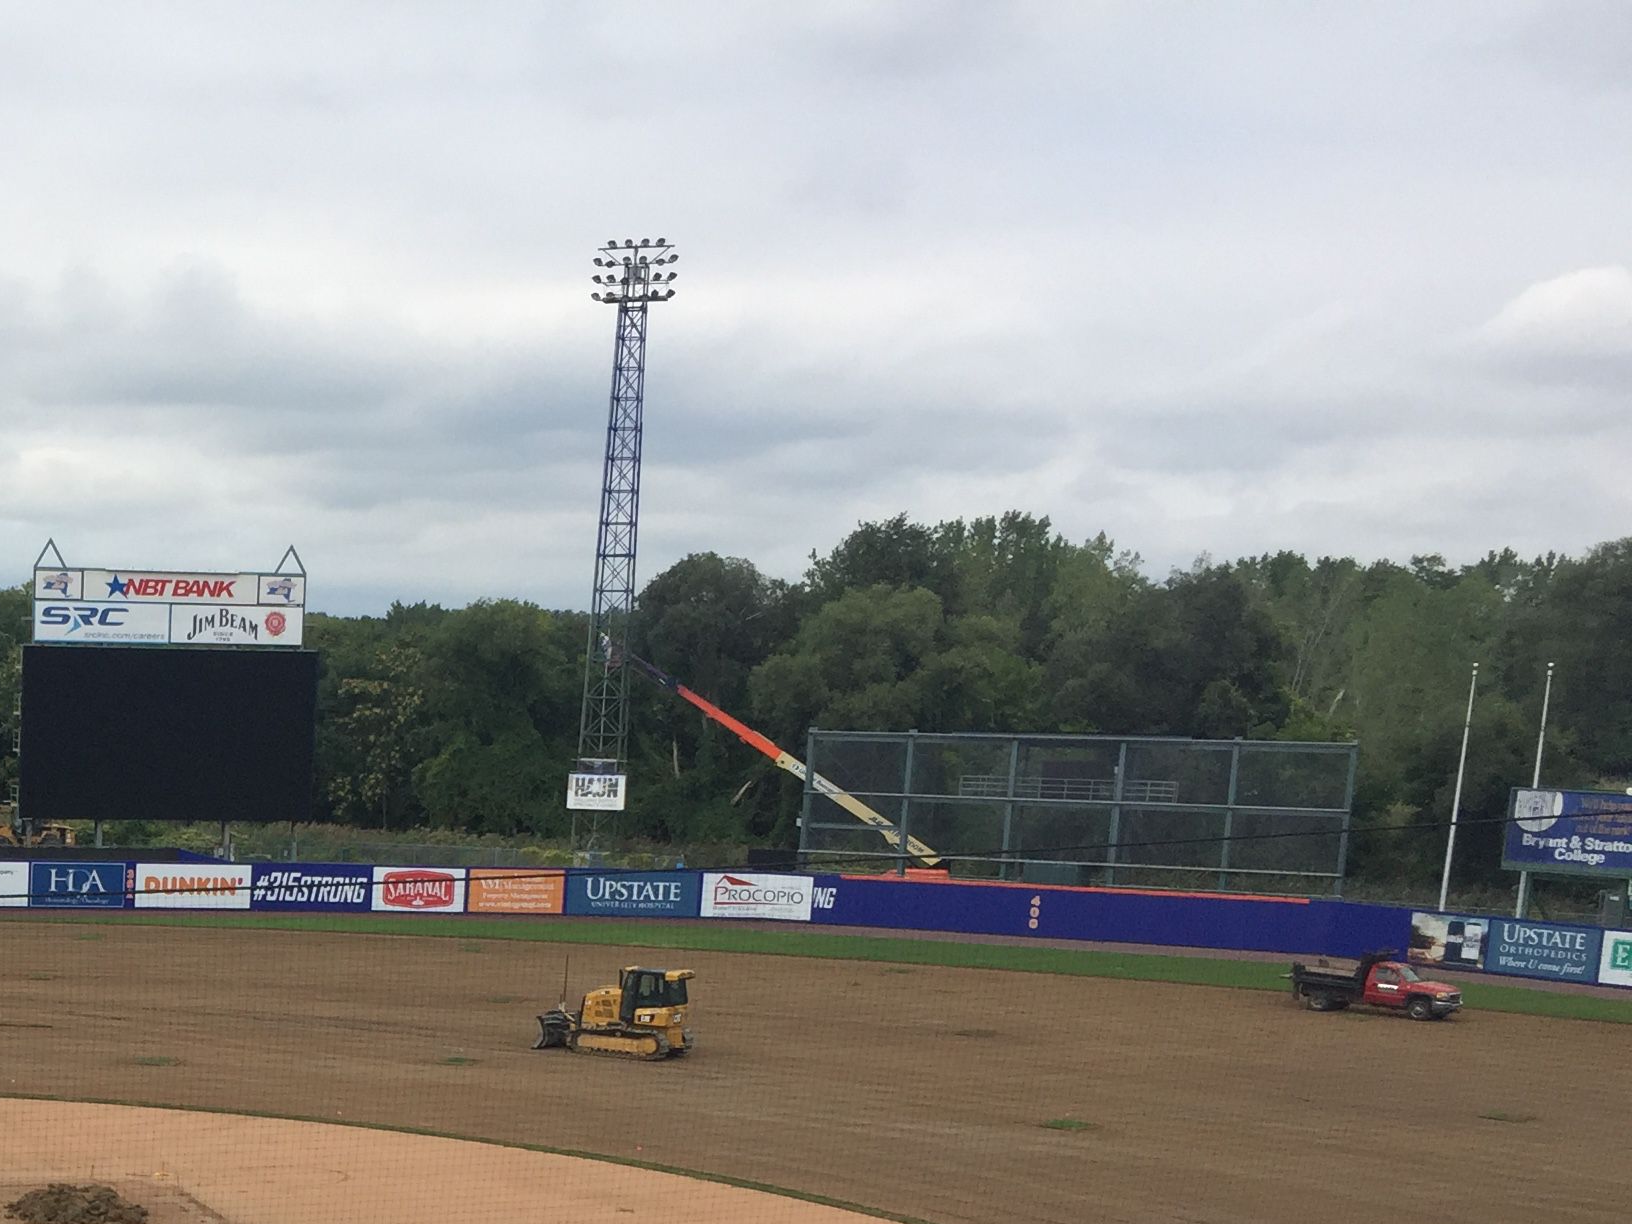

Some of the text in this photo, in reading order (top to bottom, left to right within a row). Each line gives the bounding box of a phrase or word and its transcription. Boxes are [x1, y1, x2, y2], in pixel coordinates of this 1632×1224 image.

[125, 578, 237, 598] NBT BANK
[40, 606, 129, 627] SRC
[187, 608, 258, 641] JIM BEAM
[1522, 833, 1632, 853] Bryant & Stratto
[1554, 848, 1606, 865] College
[144, 875, 244, 897] DUNKIN'
[253, 872, 368, 904] #315STRONG
[387, 878, 449, 901] SARANAC
[585, 877, 682, 902] UPSTATE
[714, 886, 804, 905] PROCOPIO
[638, 902, 675, 910] HOSPITAL
[1028, 895, 1041, 929] 400
[1503, 923, 1587, 950] UPSTATE
[1499, 944, 1587, 962] ORTHOPEDICS
[1499, 956, 1526, 968] Where
[1527, 959, 1538, 969] U
[1560, 963, 1586, 976] first!
